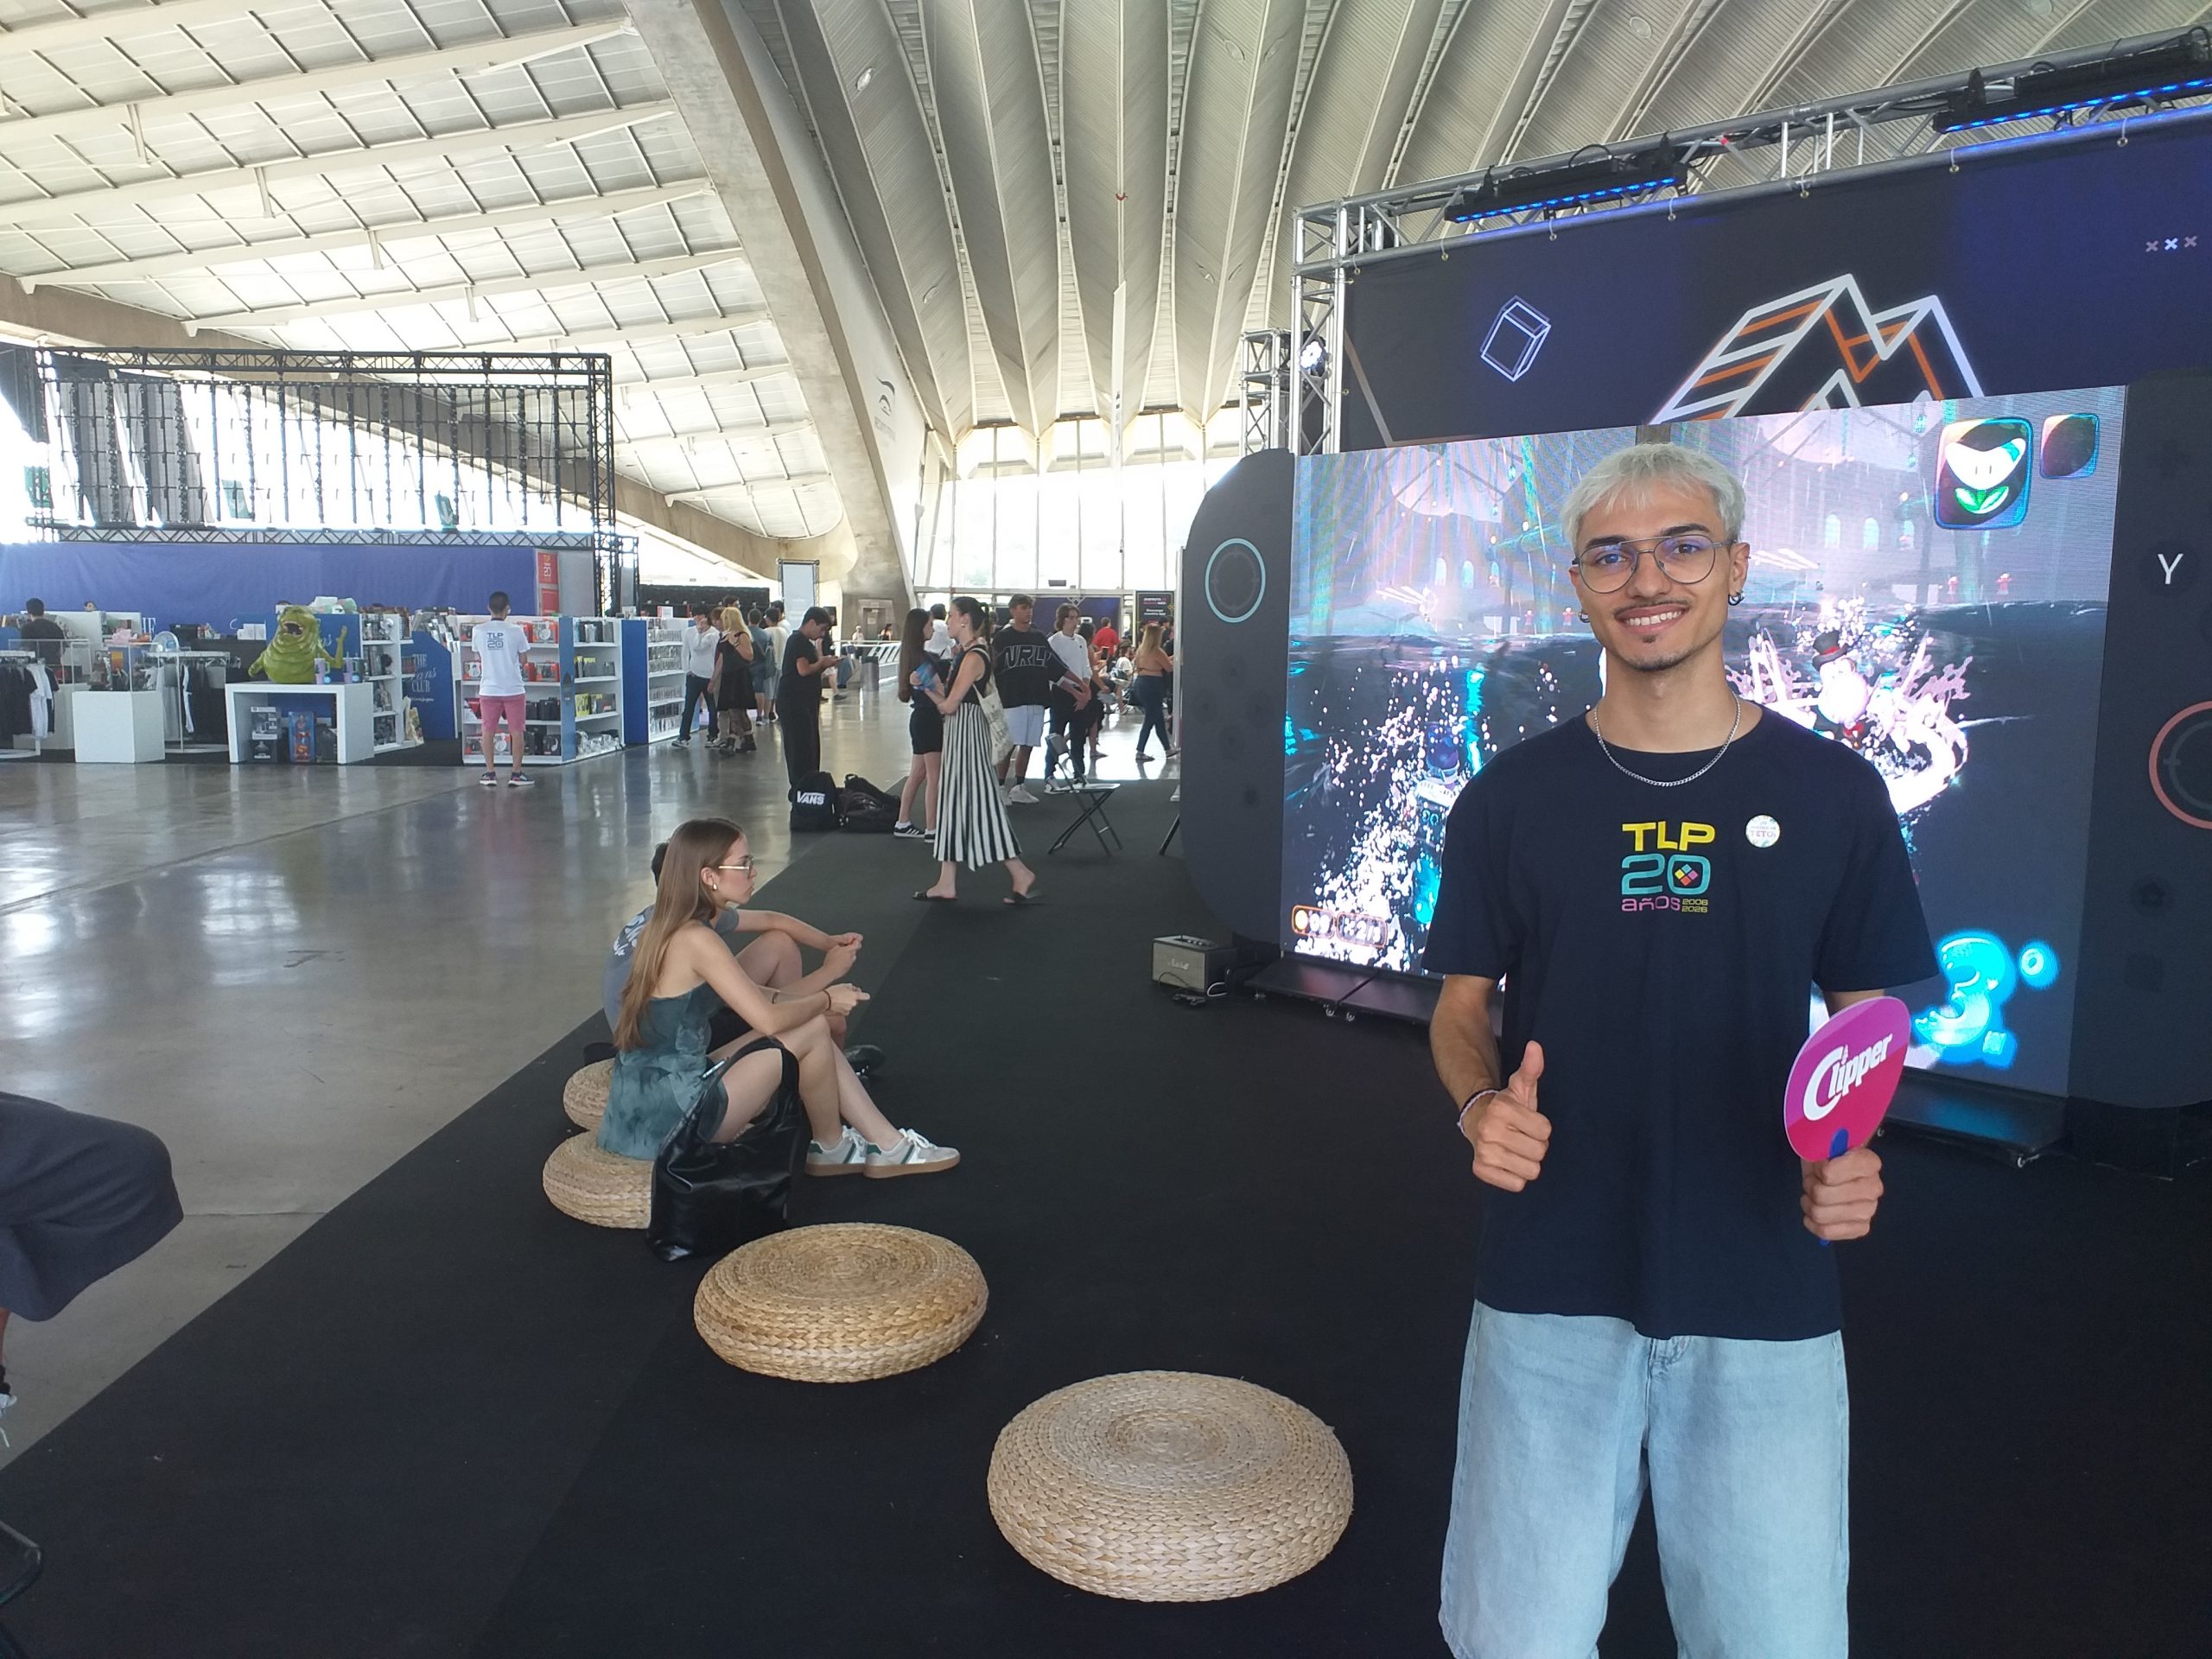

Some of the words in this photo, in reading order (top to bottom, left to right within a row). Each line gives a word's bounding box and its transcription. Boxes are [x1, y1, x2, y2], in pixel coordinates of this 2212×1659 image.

[2157, 553, 2183, 585] Y
[411, 679, 430, 692] CLUB
[797, 790, 826, 805] VANS
[1622, 820, 1716, 852] TLP
[1621, 853, 1712, 895] 20
[1802, 1033, 1893, 1122] Clipper
